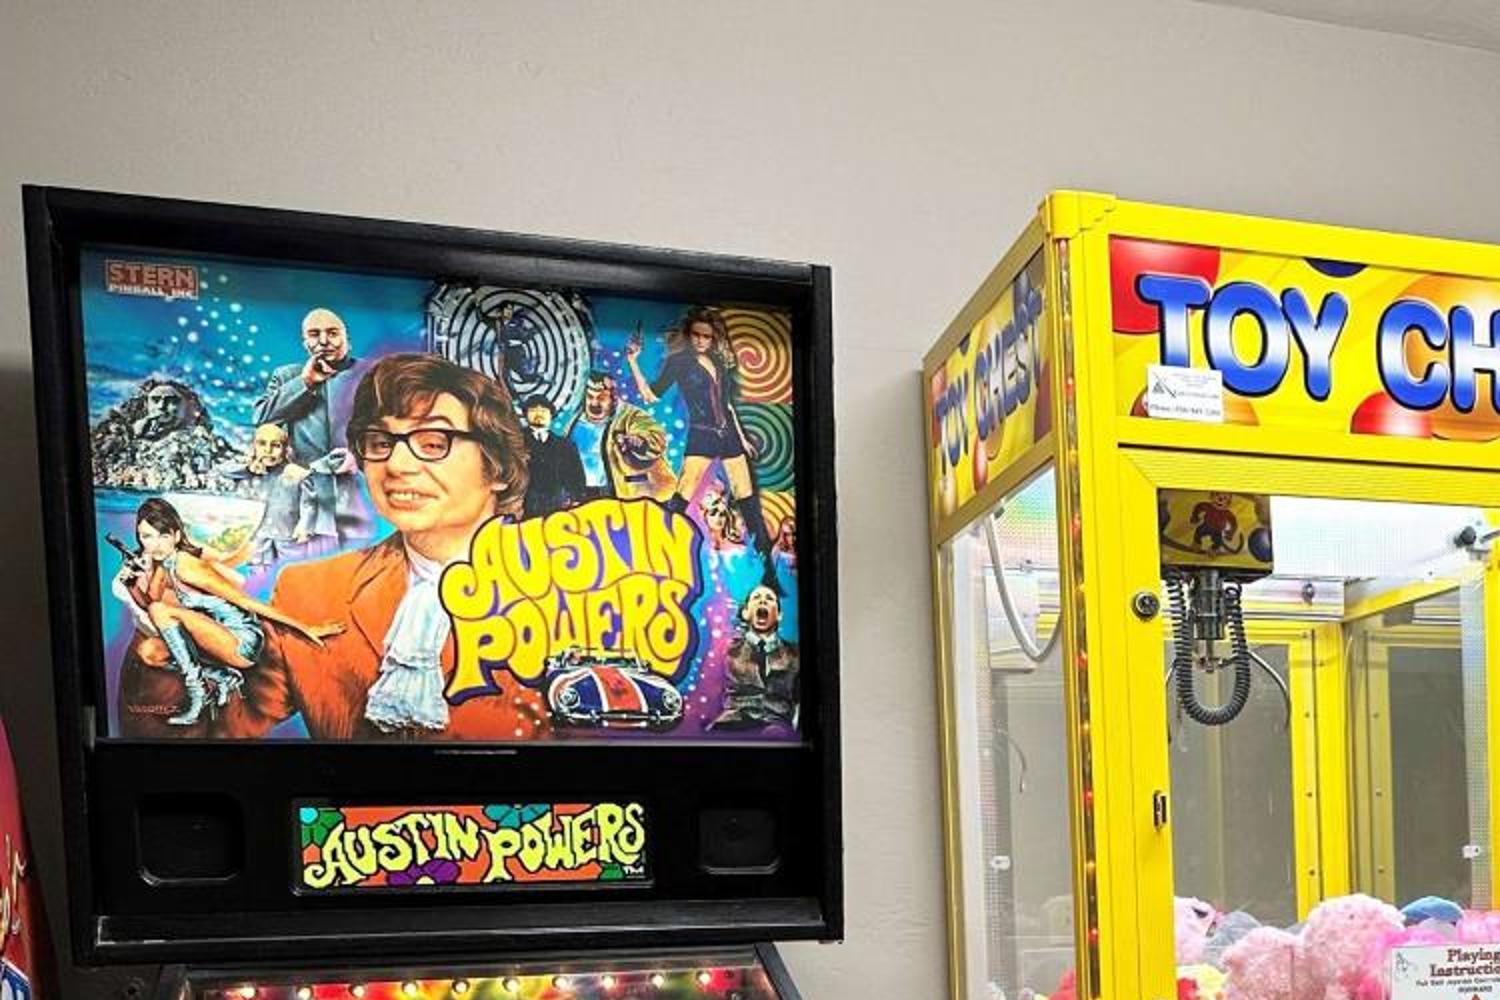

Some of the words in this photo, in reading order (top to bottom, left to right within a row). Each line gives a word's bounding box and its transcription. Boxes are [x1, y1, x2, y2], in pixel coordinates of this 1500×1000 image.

[109, 263, 195, 290] STERN
[1135, 273, 1350, 402] TOY
[935, 370, 969, 476] TOY
[974, 287, 1043, 441] CHEST
[440, 498, 698, 621] AUSTIN
[444, 573, 694, 699] POWERS
[303, 811, 483, 889] AUSTIN
[480, 802, 646, 884] POWERS
